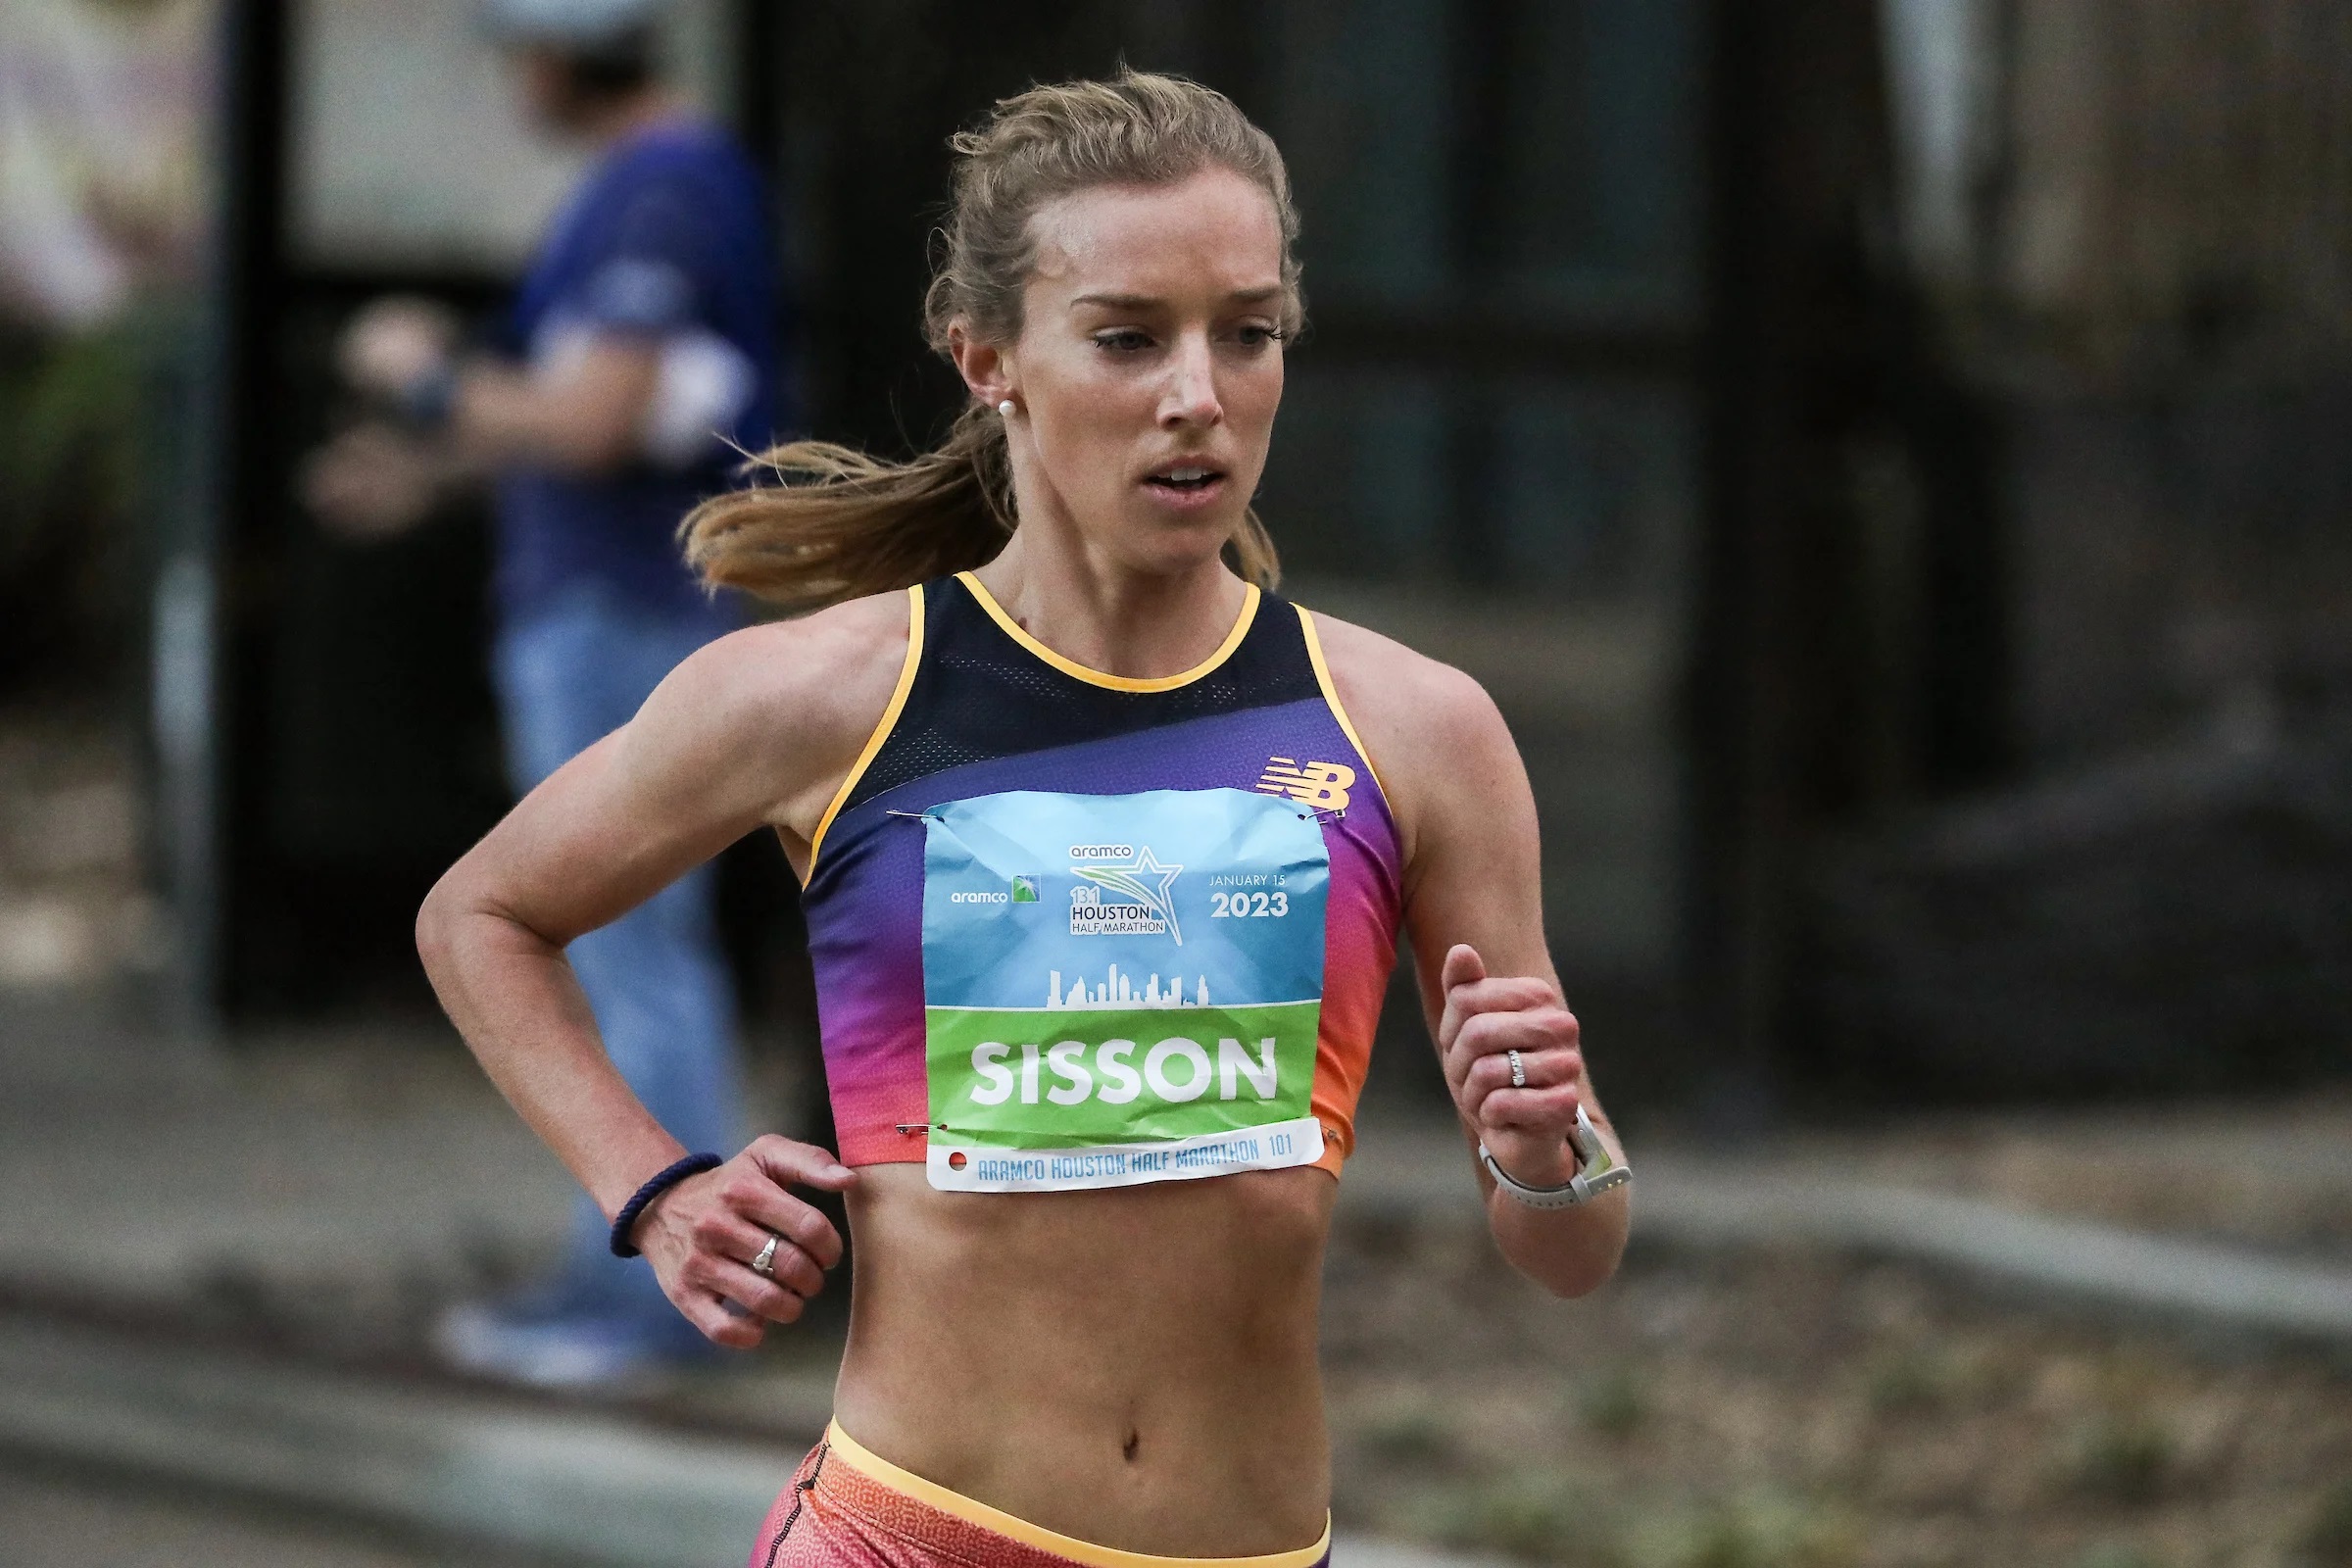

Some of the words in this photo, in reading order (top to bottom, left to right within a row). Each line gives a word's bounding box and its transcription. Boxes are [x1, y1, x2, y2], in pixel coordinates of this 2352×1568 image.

[1071, 846, 1132, 858] aramco
[1209, 874, 1268, 886] JANUARY
[1273, 874, 1286, 886] 15
[951, 892, 1008, 904] aramco
[1072, 888, 1099, 904] 13.1
[1210, 892, 1289, 918] 2023
[1072, 906, 1151, 920] HOUSTON
[1072, 922, 1100, 933] HALF
[1103, 921, 1163, 933] MARATHON
[969, 1037, 1277, 1106] SISSON
[978, 1159, 1045, 1182] ARAMCO
[1051, 1153, 1127, 1179] HOUSTON
[1132, 1151, 1169, 1173] HALF
[1176, 1138, 1260, 1169] MARATHON
[1268, 1133, 1293, 1156] 101
